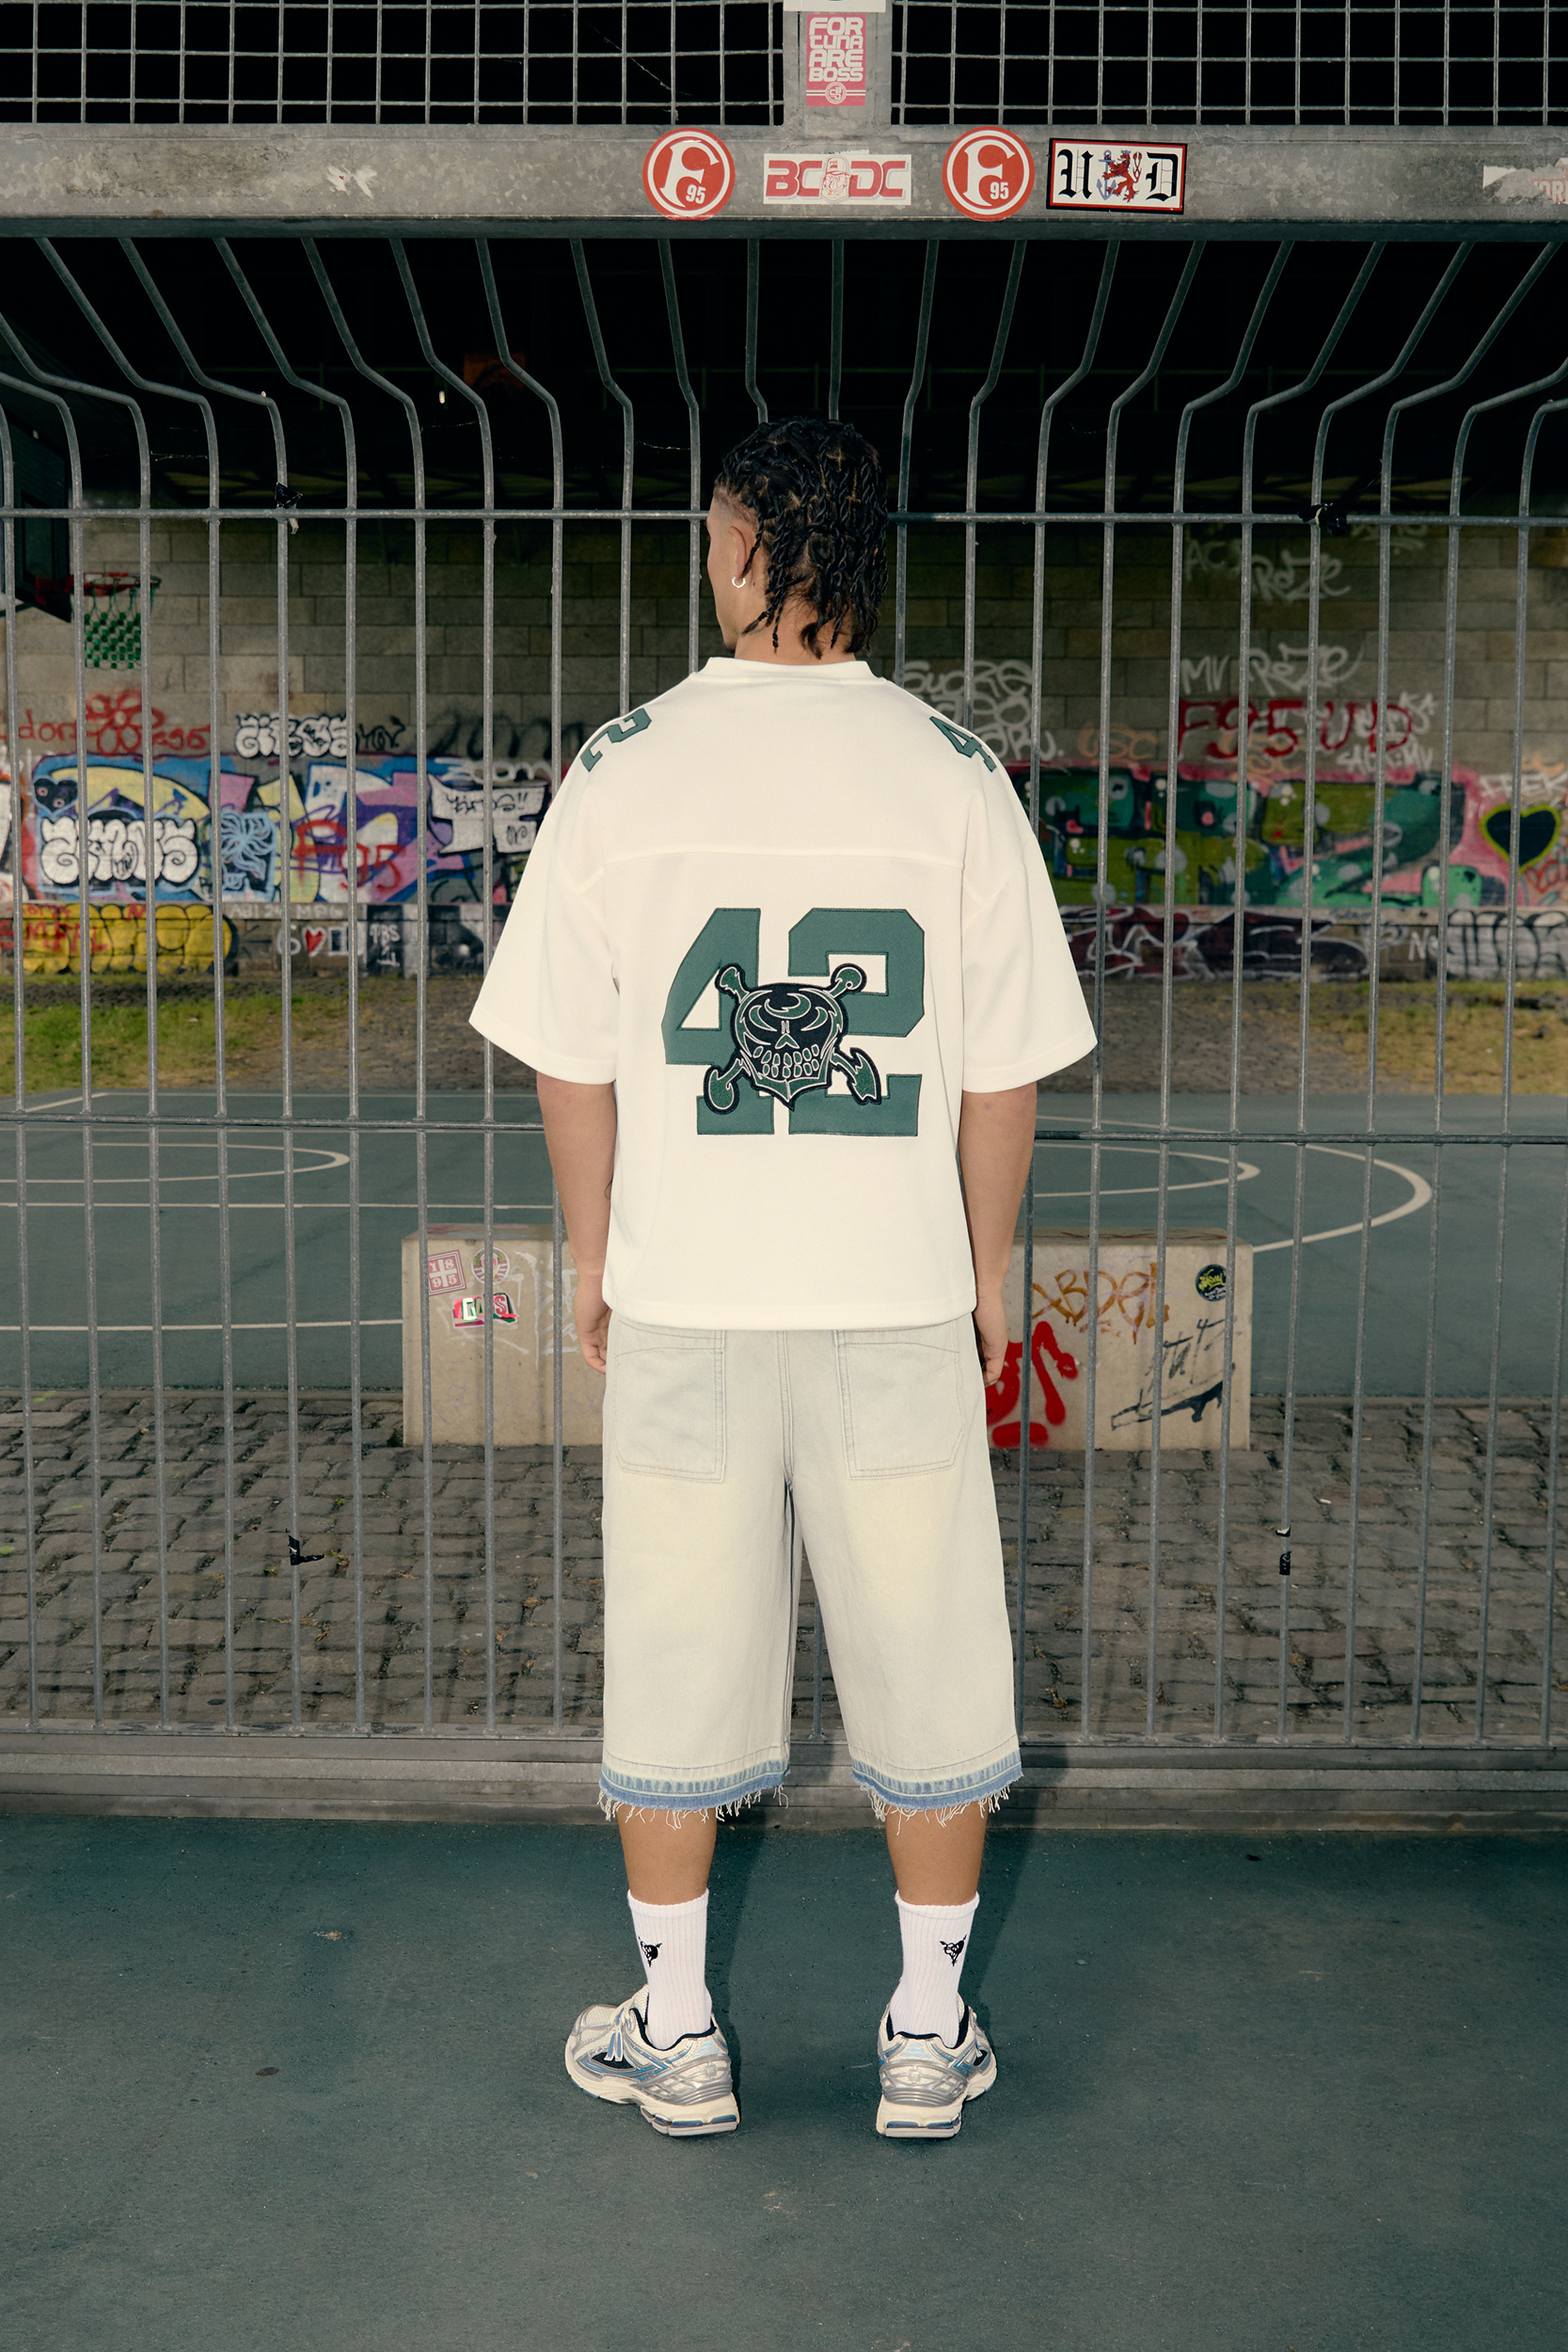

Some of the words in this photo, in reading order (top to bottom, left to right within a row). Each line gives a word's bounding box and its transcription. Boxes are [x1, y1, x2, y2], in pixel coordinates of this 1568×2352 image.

[809, 17, 863, 36] FOR
[809, 49, 863, 67] ARE
[809, 67, 863, 82] BOSS
[686, 183, 706, 204] 95
[990, 182, 1009, 199] 95
[661, 908, 925, 1136] 42
